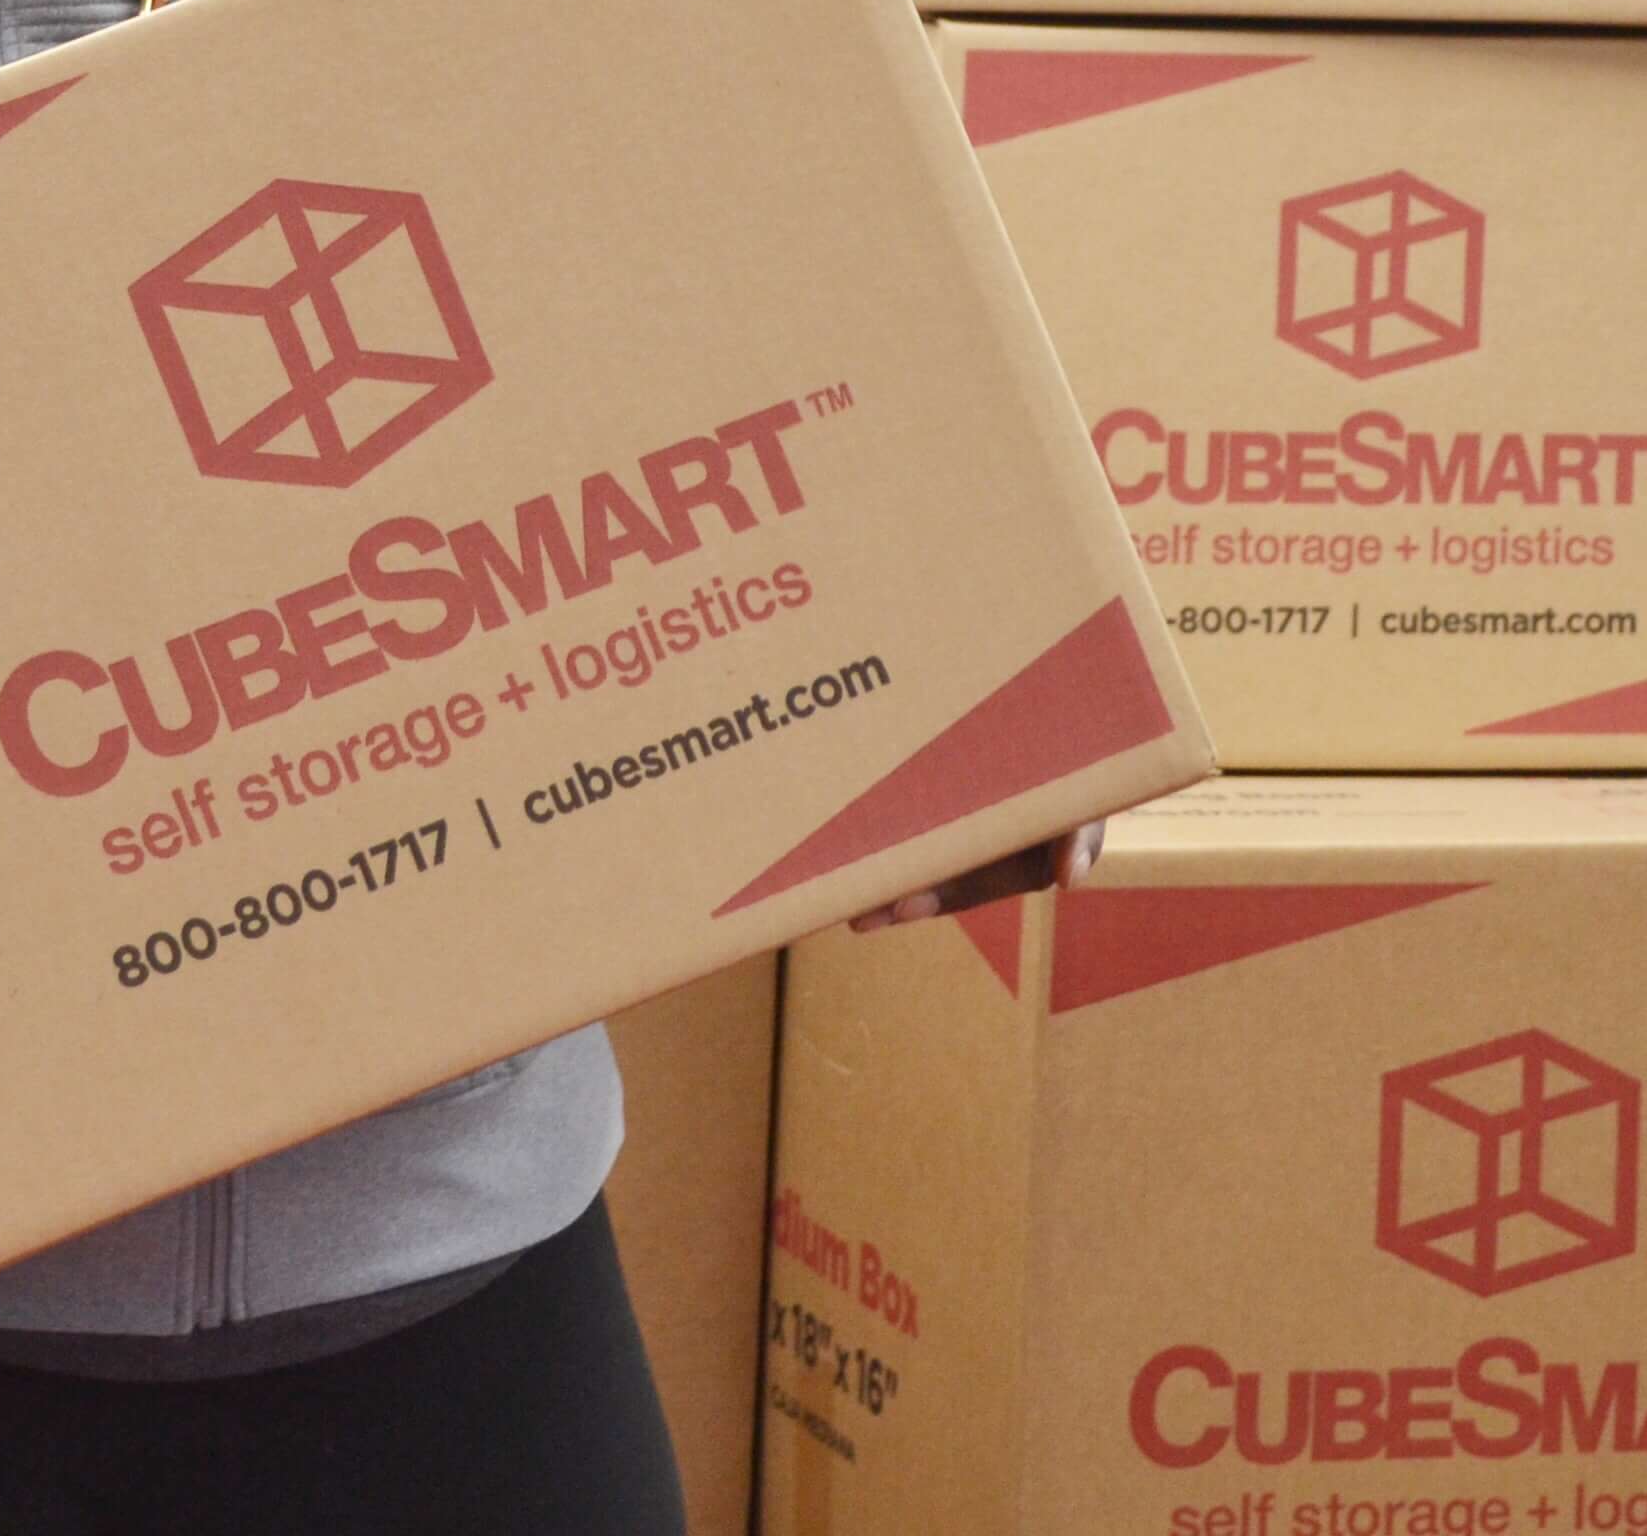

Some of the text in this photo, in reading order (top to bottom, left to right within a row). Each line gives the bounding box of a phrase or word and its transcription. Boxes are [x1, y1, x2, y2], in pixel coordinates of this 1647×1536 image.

[1213, 528, 1382, 577] storage
[1431, 527, 1616, 577] logistics
[1168, 606, 1331, 636] -800-1717
[1380, 604, 1638, 636] cubesmart.com
[102, 783, 222, 876] self
[238, 690, 487, 824] storage
[540, 561, 814, 700] logistics
[112, 818, 450, 988] 800-800-1717
[522, 653, 890, 824] cubesmart.com
[772, 1188, 919, 1338] dium Box
[792, 1302, 833, 1367] 18"
[834, 1343, 850, 1394] x
[855, 1346, 899, 1416] 16"
[1168, 1491, 1276, 1536] self
[1293, 1493, 1512, 1536] storage
